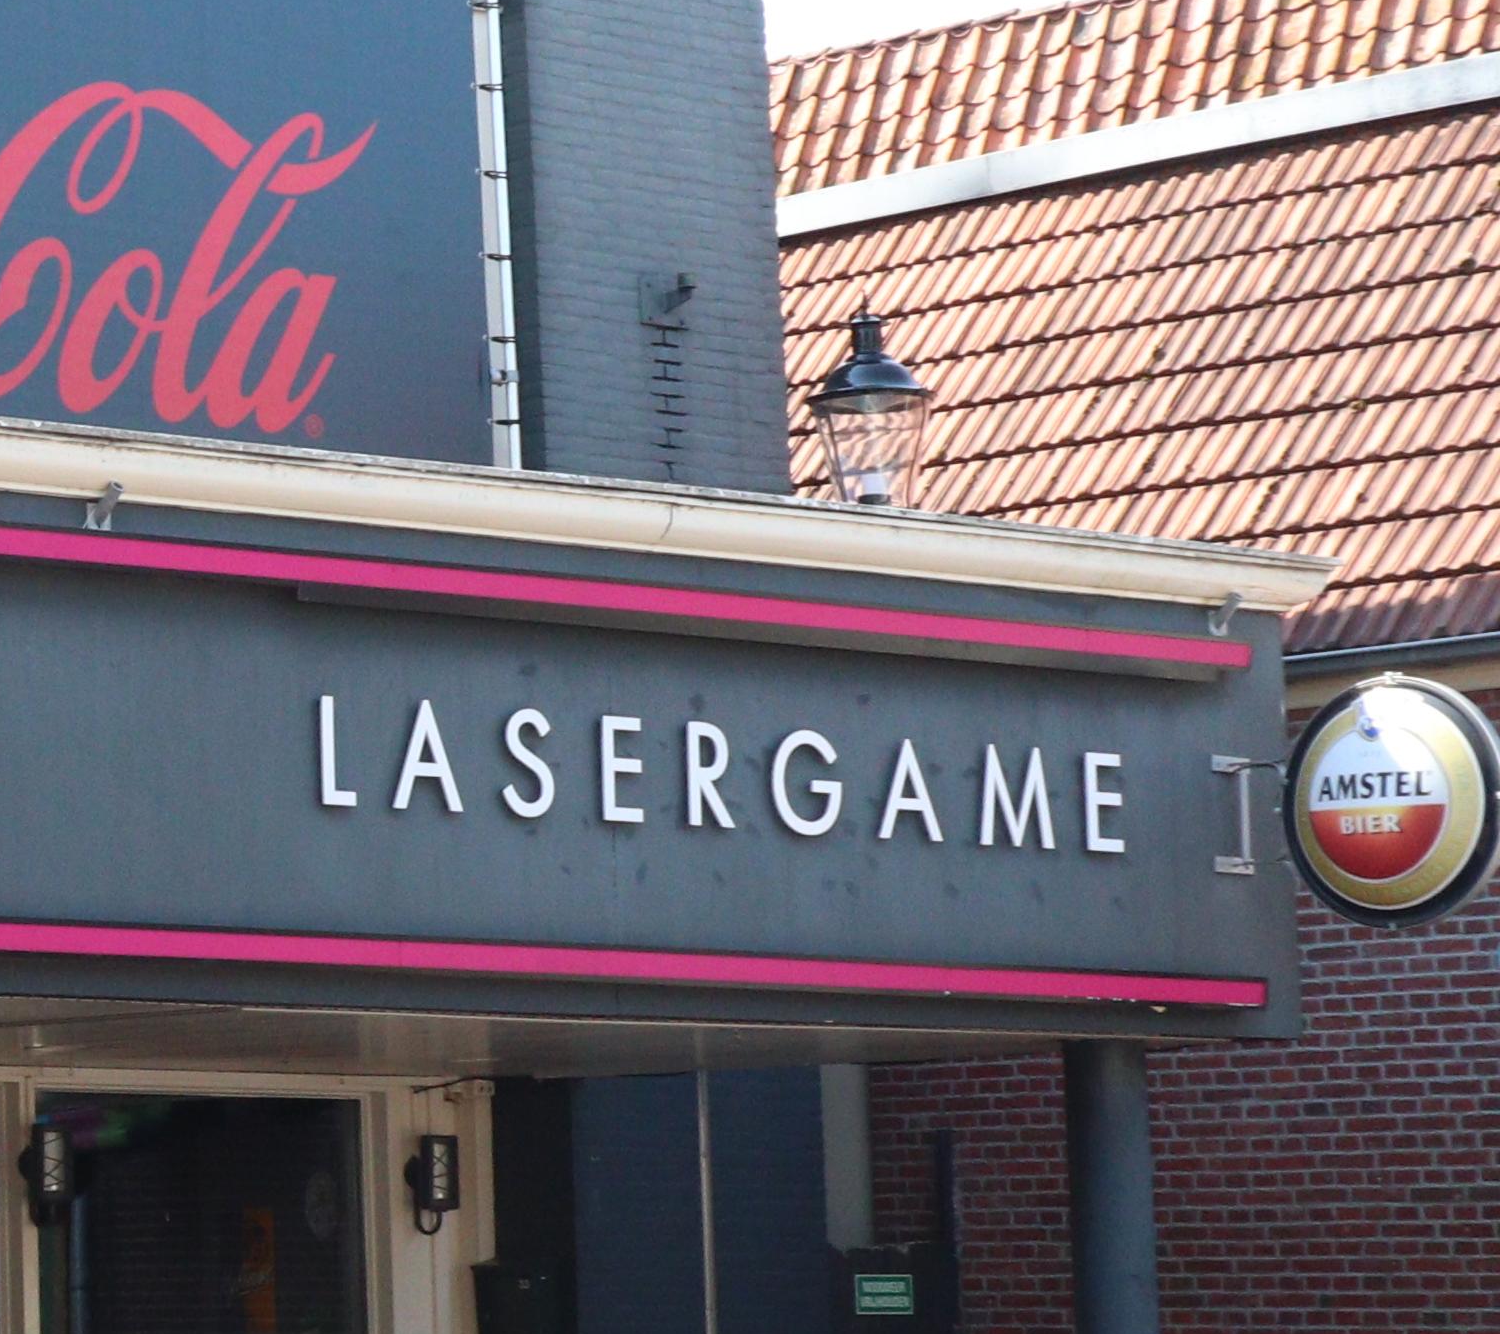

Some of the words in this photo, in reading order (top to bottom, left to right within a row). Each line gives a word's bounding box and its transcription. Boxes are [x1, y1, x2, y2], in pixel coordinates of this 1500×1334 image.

[319, 695, 1126, 854] LASERGAME
[1318, 770, 1432, 802] AMSTEL
[1340, 813, 1403, 835] BIER
